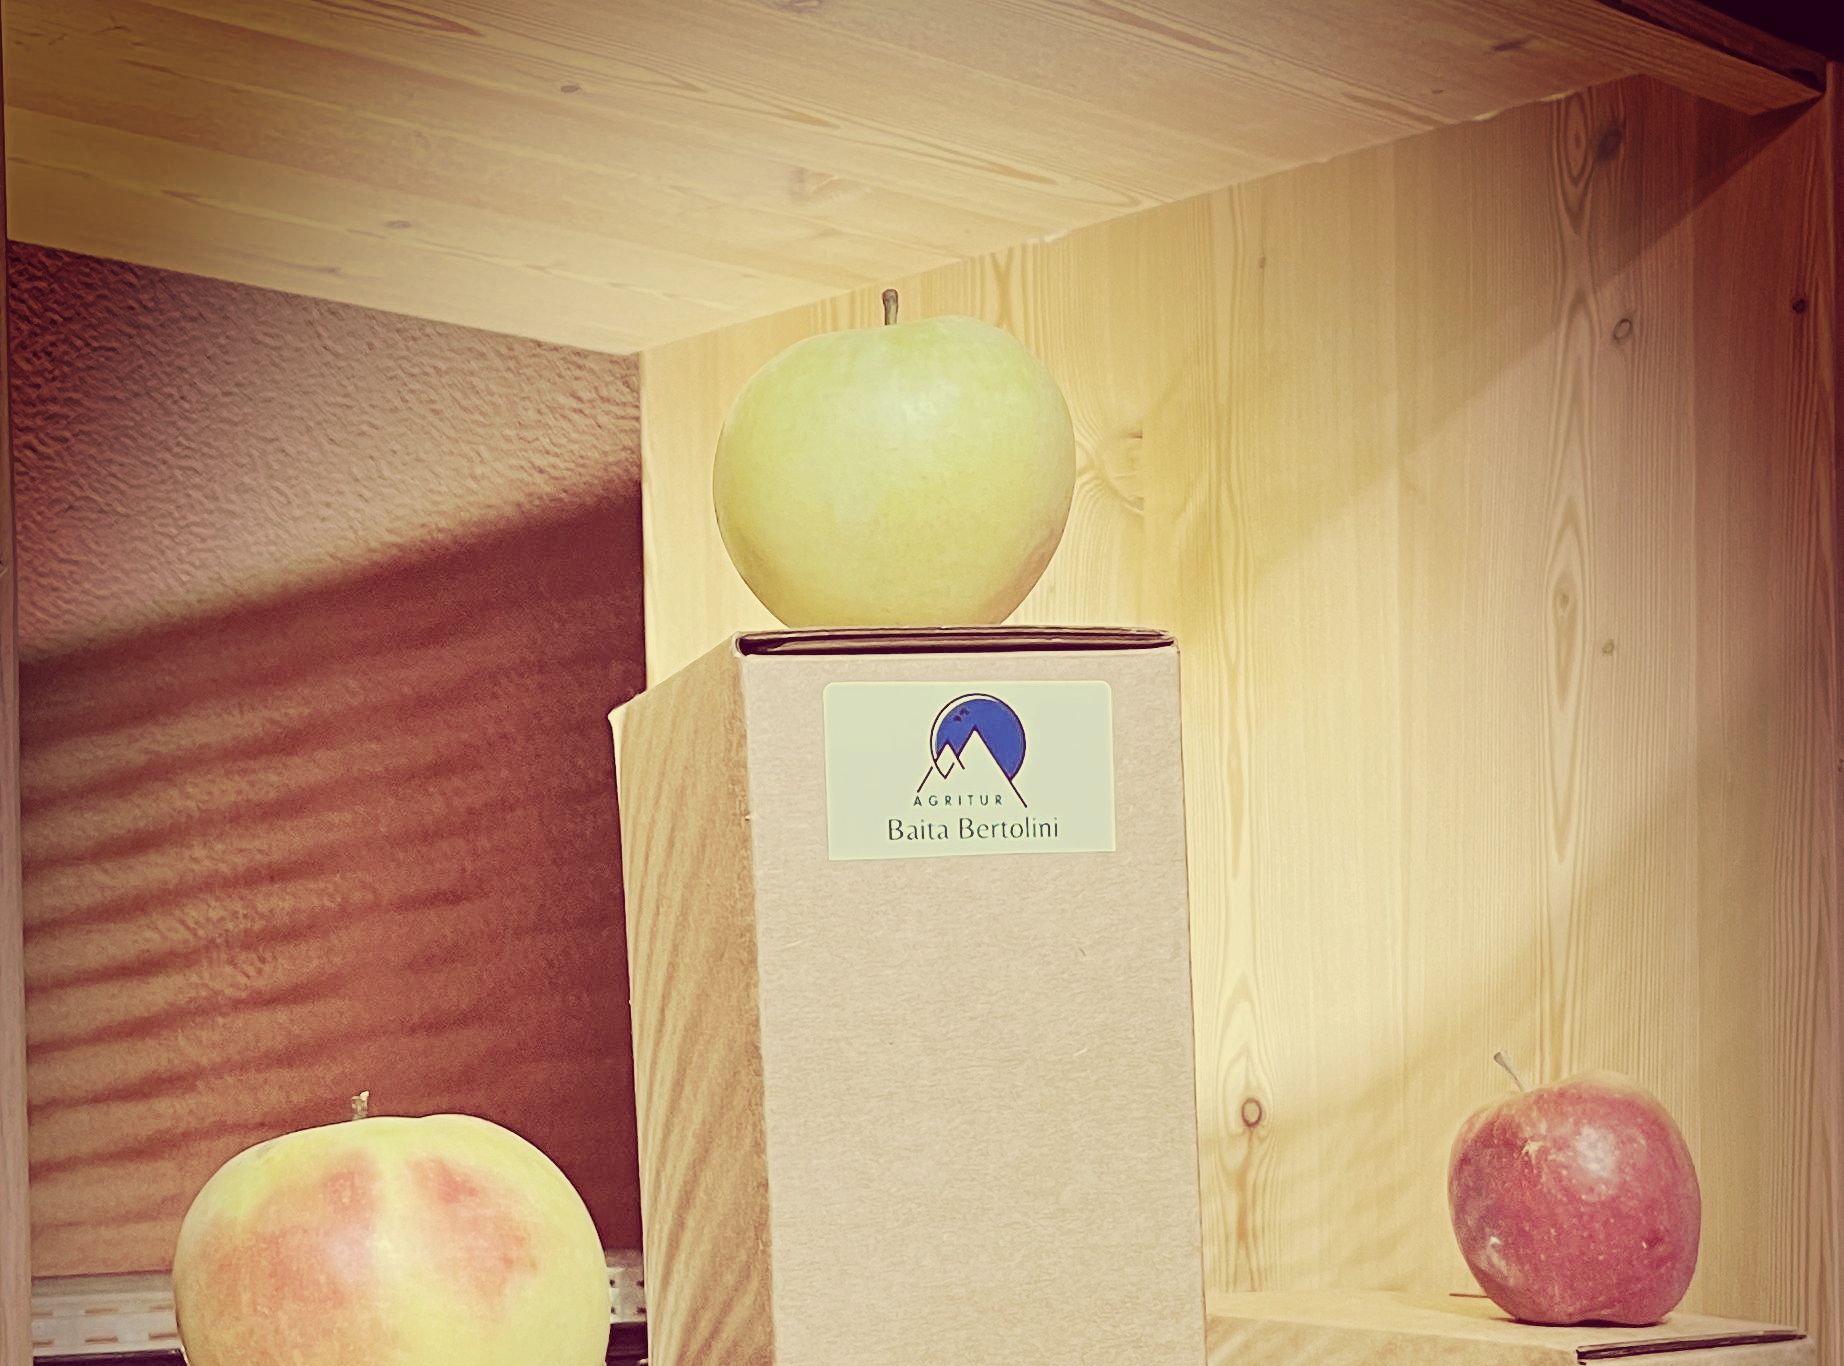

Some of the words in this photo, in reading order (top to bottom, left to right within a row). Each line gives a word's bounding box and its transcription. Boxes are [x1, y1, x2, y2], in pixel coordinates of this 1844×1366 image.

[913, 794, 1003, 807] AGRITUR
[888, 818, 949, 841] Baita
[959, 816, 1058, 840] Bertolini
